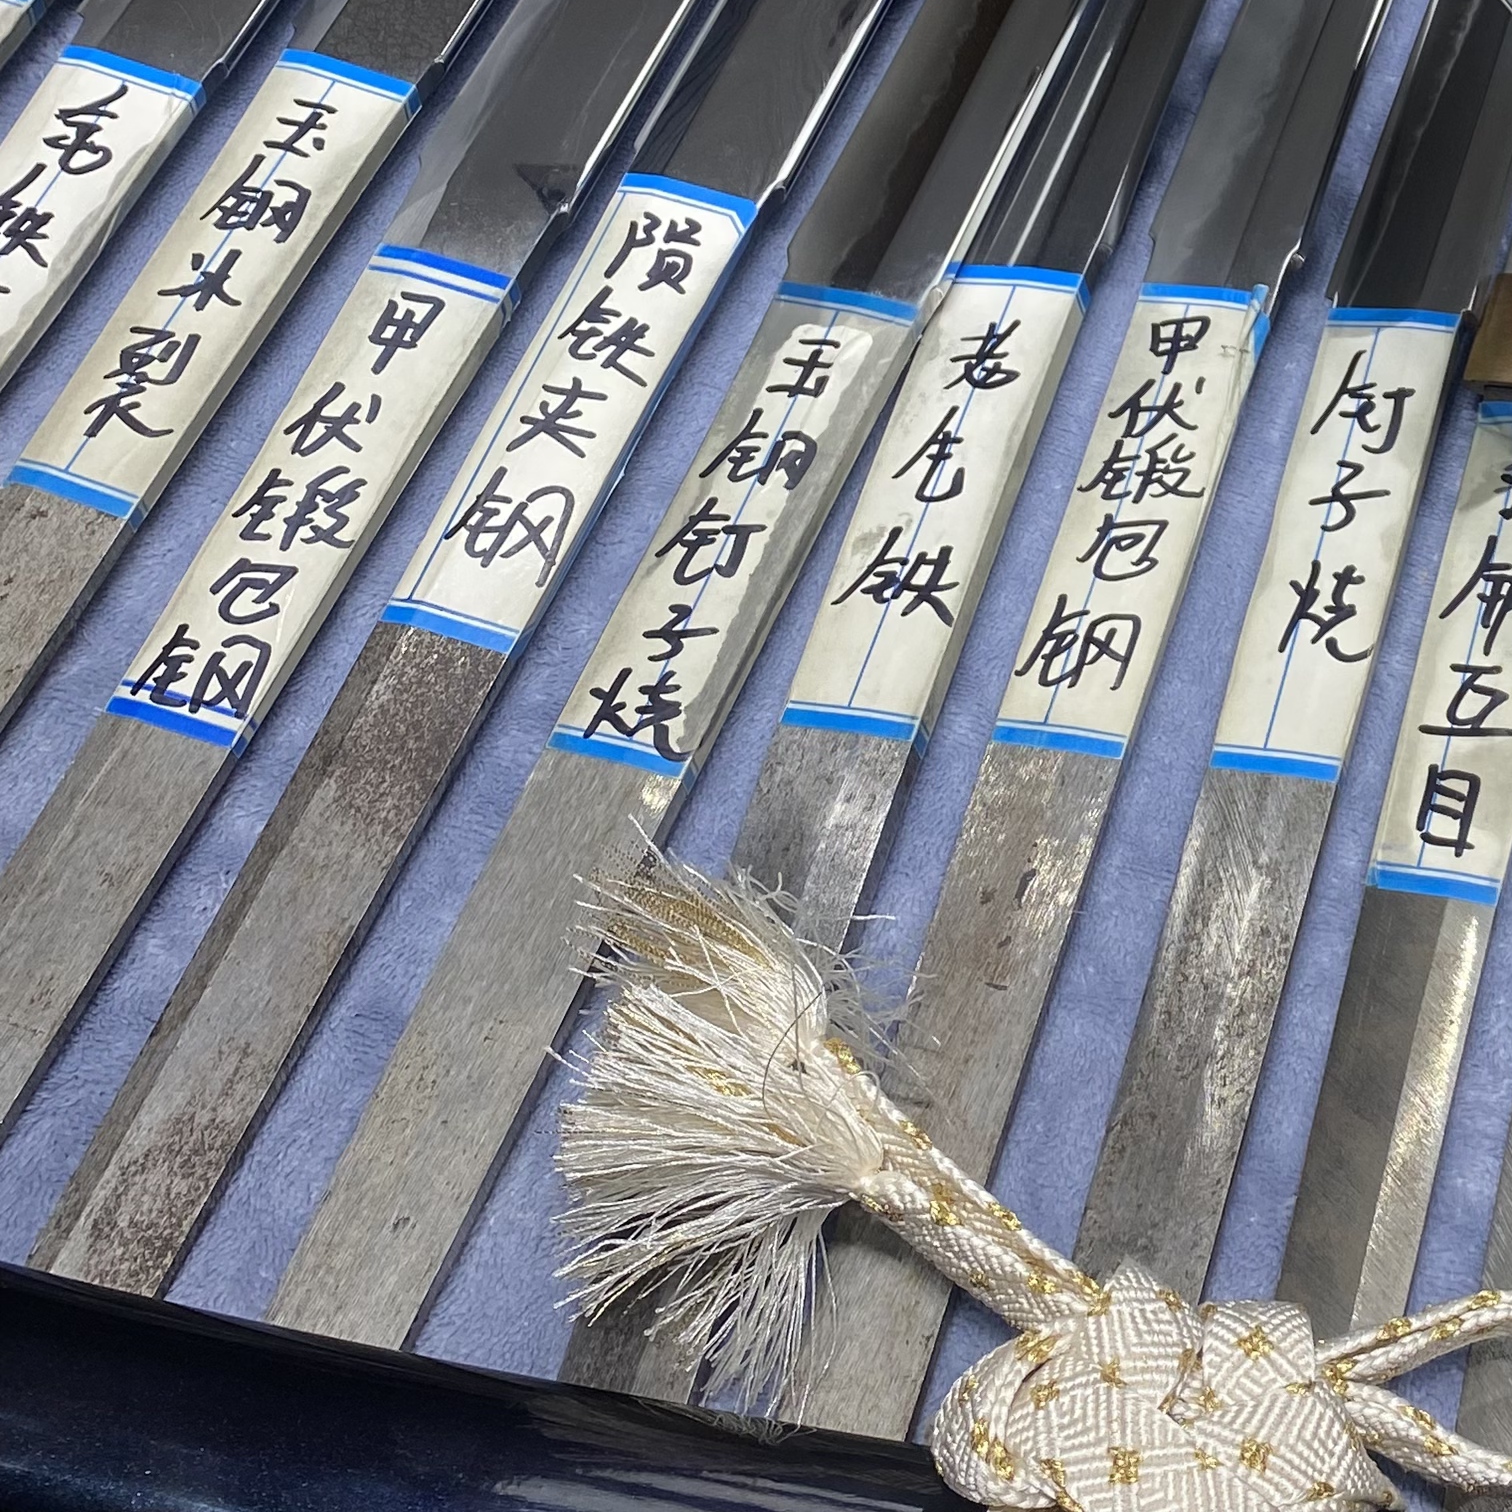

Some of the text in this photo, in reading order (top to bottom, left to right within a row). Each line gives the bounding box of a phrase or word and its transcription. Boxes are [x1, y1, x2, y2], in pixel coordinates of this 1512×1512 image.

[0, 83, 130, 294] 毛铁
[130, 291, 445, 720] 甲伏锻包钢
[444, 211, 702, 588] 陨铁夹钢
[1015, 316, 1211, 691] 甲伏锻包钢
[1279, 350, 1415, 663] 钉子烧
